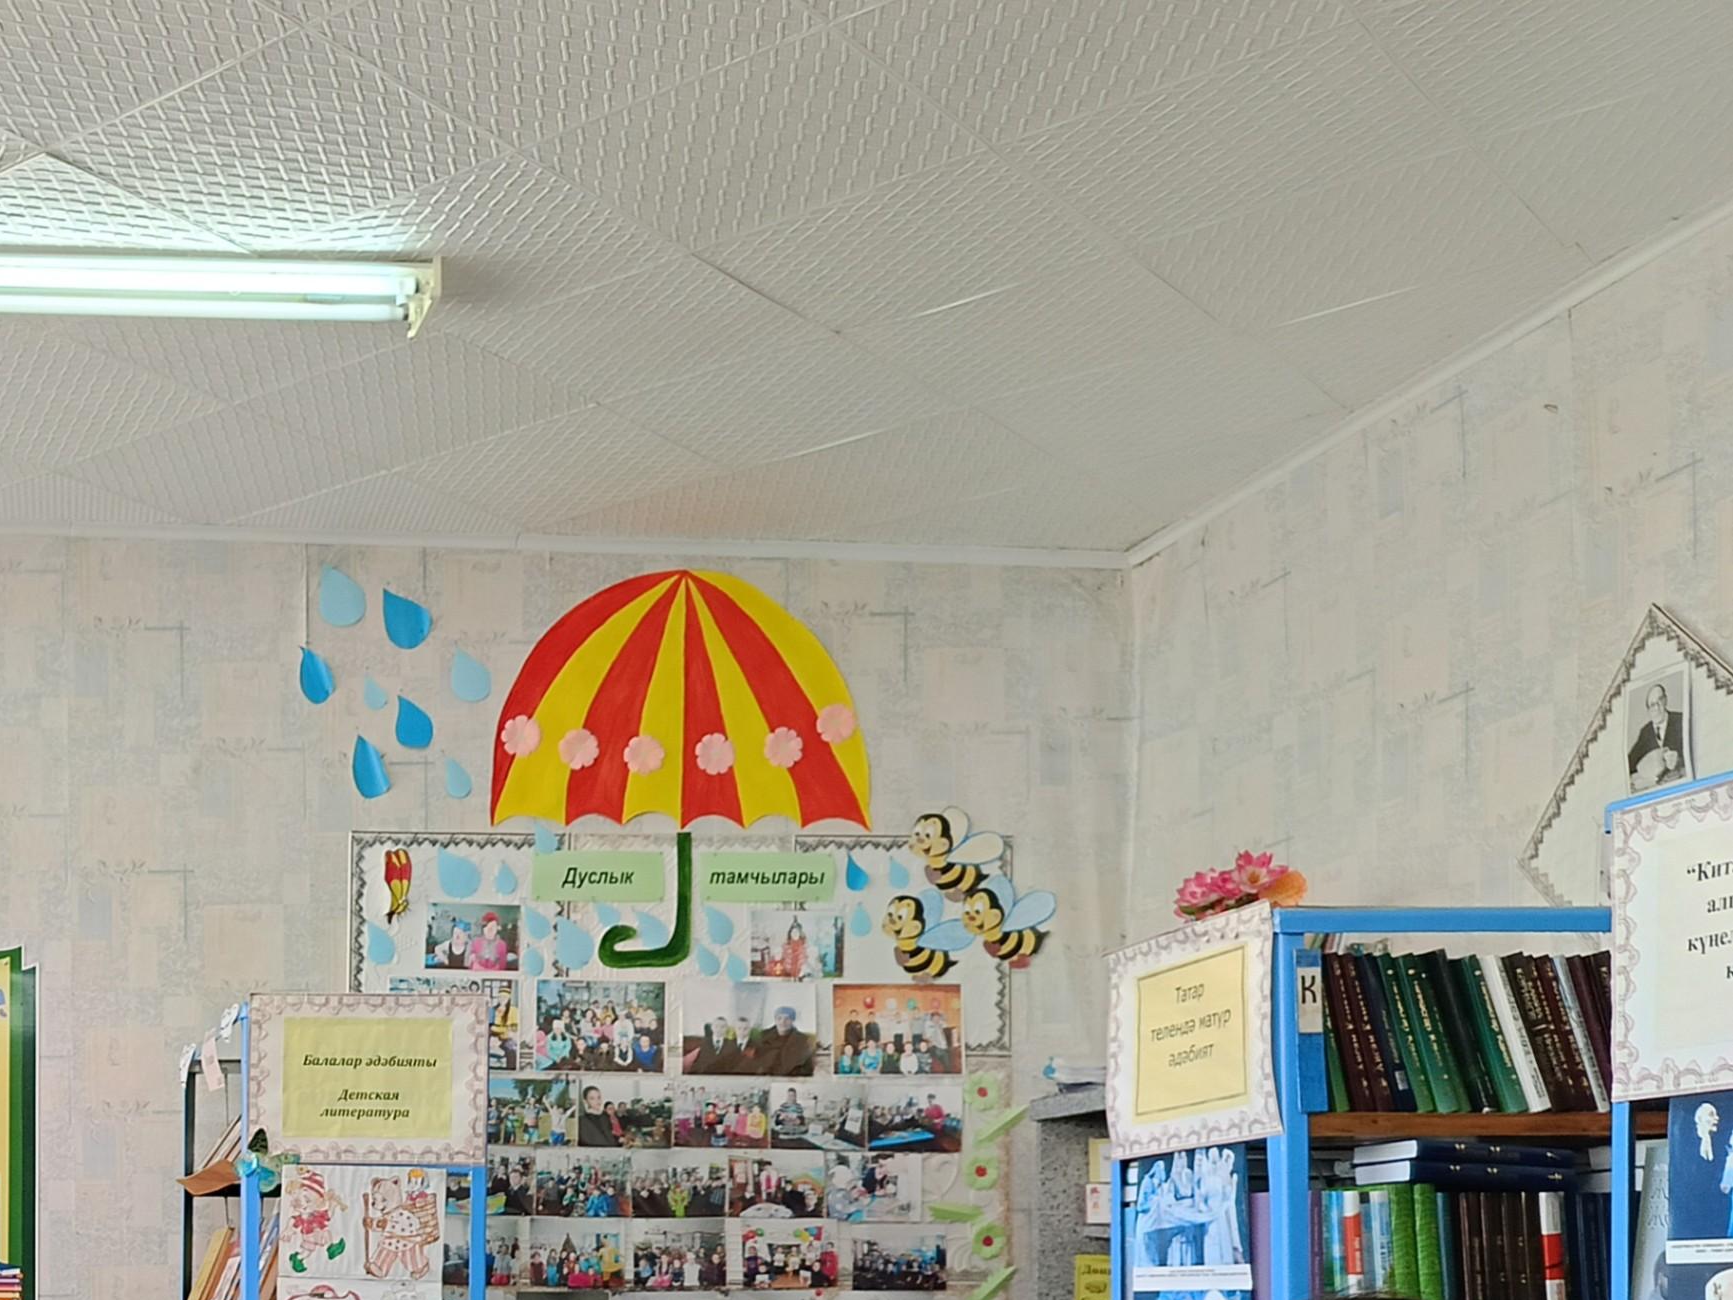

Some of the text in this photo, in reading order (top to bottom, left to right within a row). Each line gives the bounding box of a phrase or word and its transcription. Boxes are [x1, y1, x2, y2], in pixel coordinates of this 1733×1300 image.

[561, 867, 825, 888] Дуслык тамчылары
[1175, 983, 1205, 1004] Татар
[1301, 974, 1317, 1004] К
[1151, 1009, 1232, 1042] телендә матур
[303, 1054, 437, 1069] Балалар әдәбияты
[1169, 1043, 1214, 1067] әдәбият
[337, 1089, 400, 1102] Детская
[320, 1108, 410, 1120] литература
